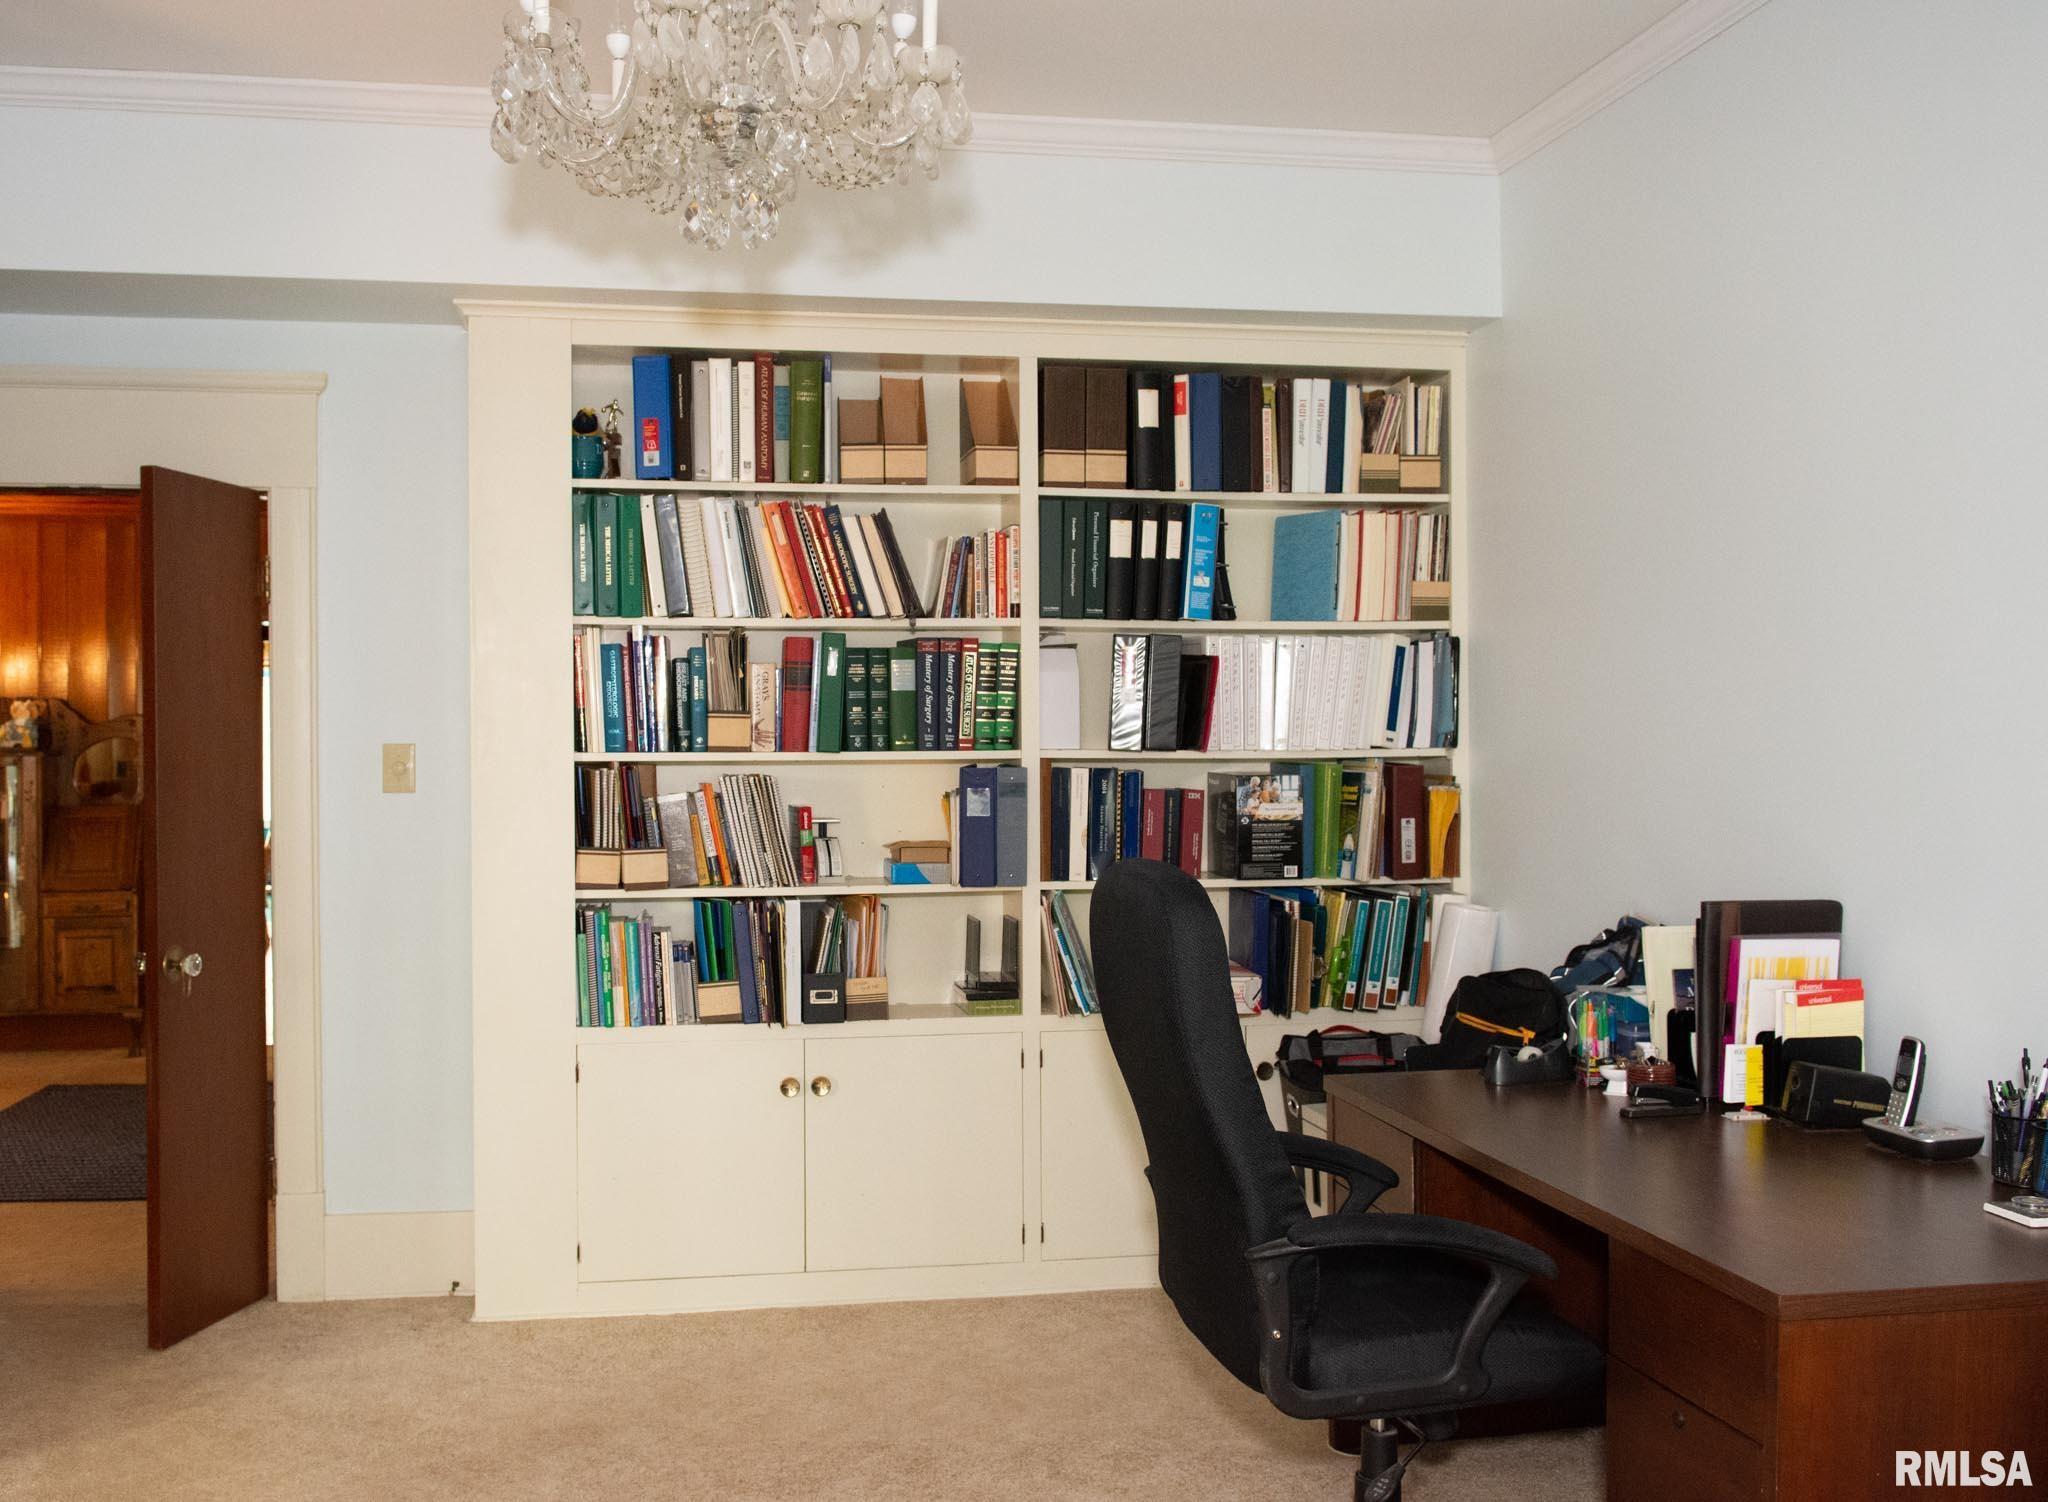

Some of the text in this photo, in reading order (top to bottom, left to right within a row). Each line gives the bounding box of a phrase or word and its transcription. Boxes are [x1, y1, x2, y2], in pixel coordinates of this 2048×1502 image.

[760, 365, 771, 470] ATLAS OF HUMAN ANATOMY
[604, 564, 612, 586] LETTER
[832, 529, 859, 595] LAPAROSCOPIC SURGERY
[609, 649, 619, 719] GASTROENTEROLOGIC
[923, 653, 934, 684] Mastery
[946, 653, 956, 684] Mastery
[754, 672, 762, 718] ANATOMY
[923, 685, 933, 696] of
[946, 685, 956, 696] of
[962, 655, 974, 736] ATLAS OF GENERAL SURGERY
[924, 695, 934, 724] Surgery
[946, 695, 956, 724] Surgery
[653, 934, 663, 987] Adrenal Fatigue
[1799, 983, 1824, 991] universal
[1808, 996, 1832, 1004] universal
